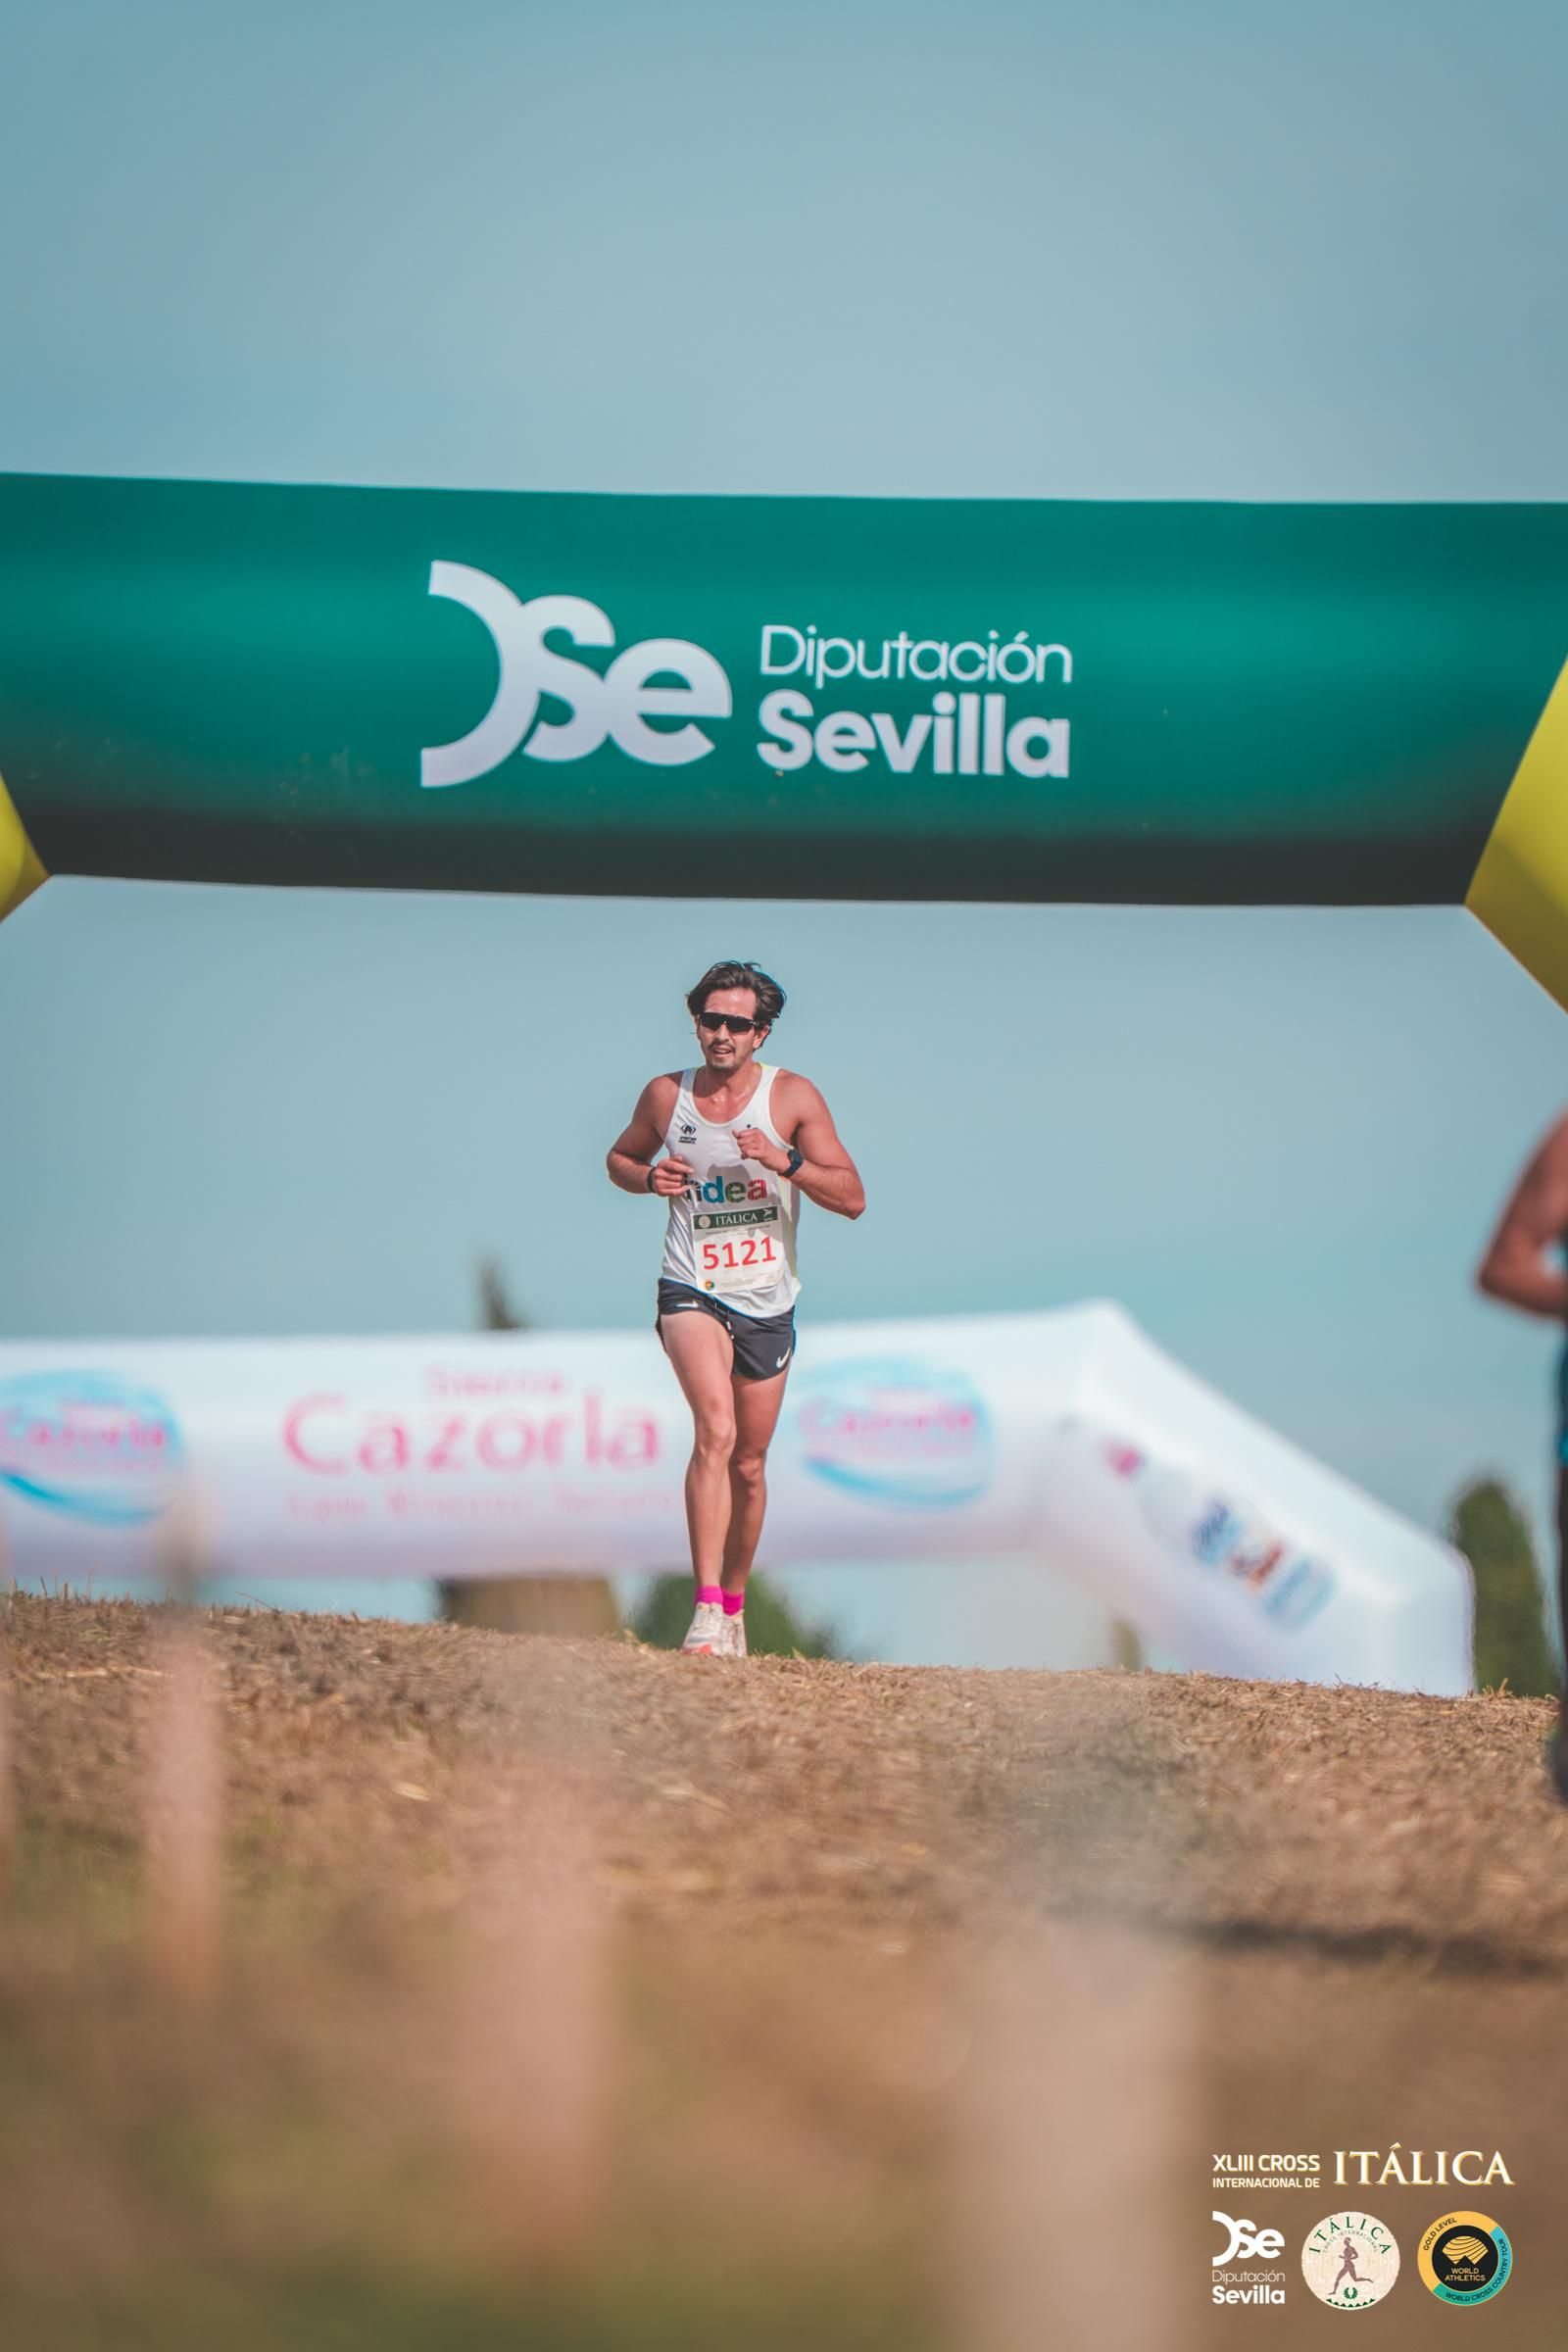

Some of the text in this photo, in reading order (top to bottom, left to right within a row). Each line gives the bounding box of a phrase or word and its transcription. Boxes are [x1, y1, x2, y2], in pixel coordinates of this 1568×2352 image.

[760, 624, 1073, 689] Diputación
[757, 690, 1070, 779] Sevilla
[715, 1212, 759, 1226] ITÁLICA
[703, 1236, 777, 1270] 5121
[280, 1388, 661, 1475] Cazorla
